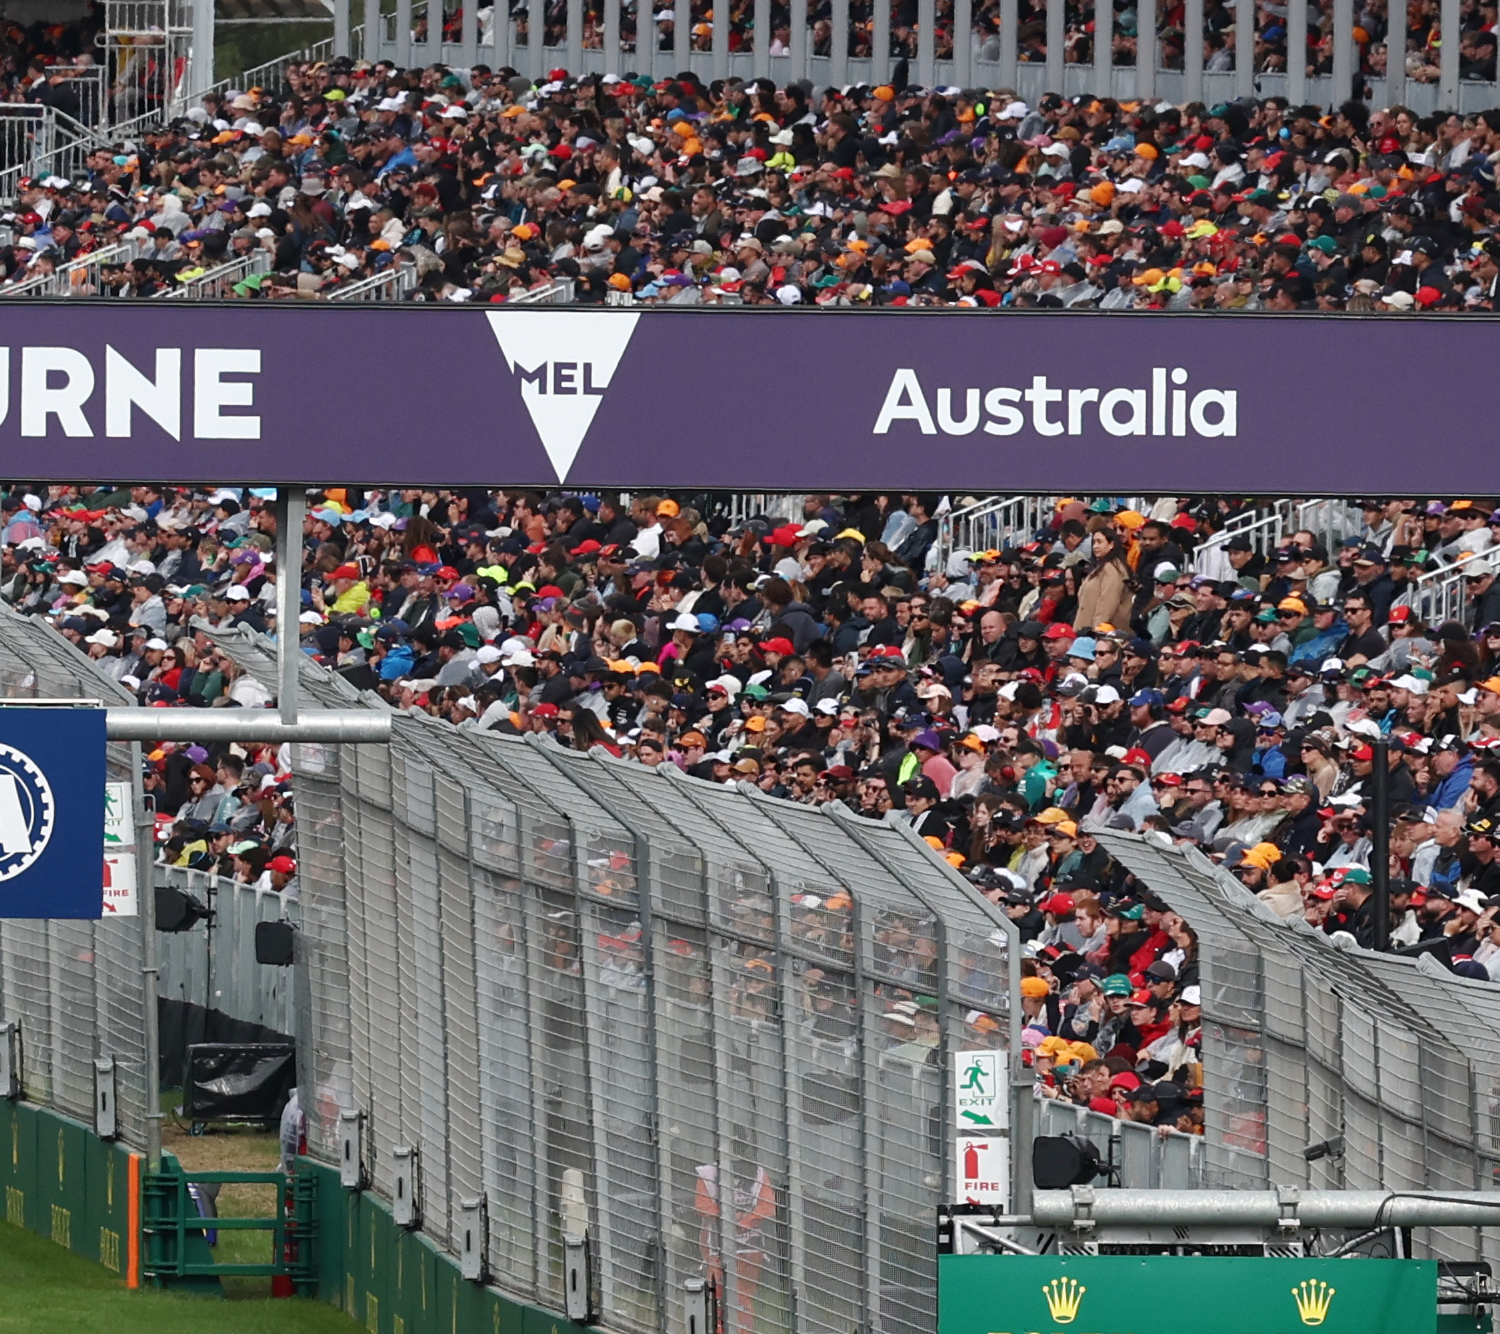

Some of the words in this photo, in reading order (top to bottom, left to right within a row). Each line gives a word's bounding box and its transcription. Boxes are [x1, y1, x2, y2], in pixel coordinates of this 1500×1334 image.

[513, 360, 608, 396] MEL
[872, 367, 1237, 438] Australia
[958, 1098, 995, 1107] EXIT
[964, 1182, 1001, 1191] FIRE
